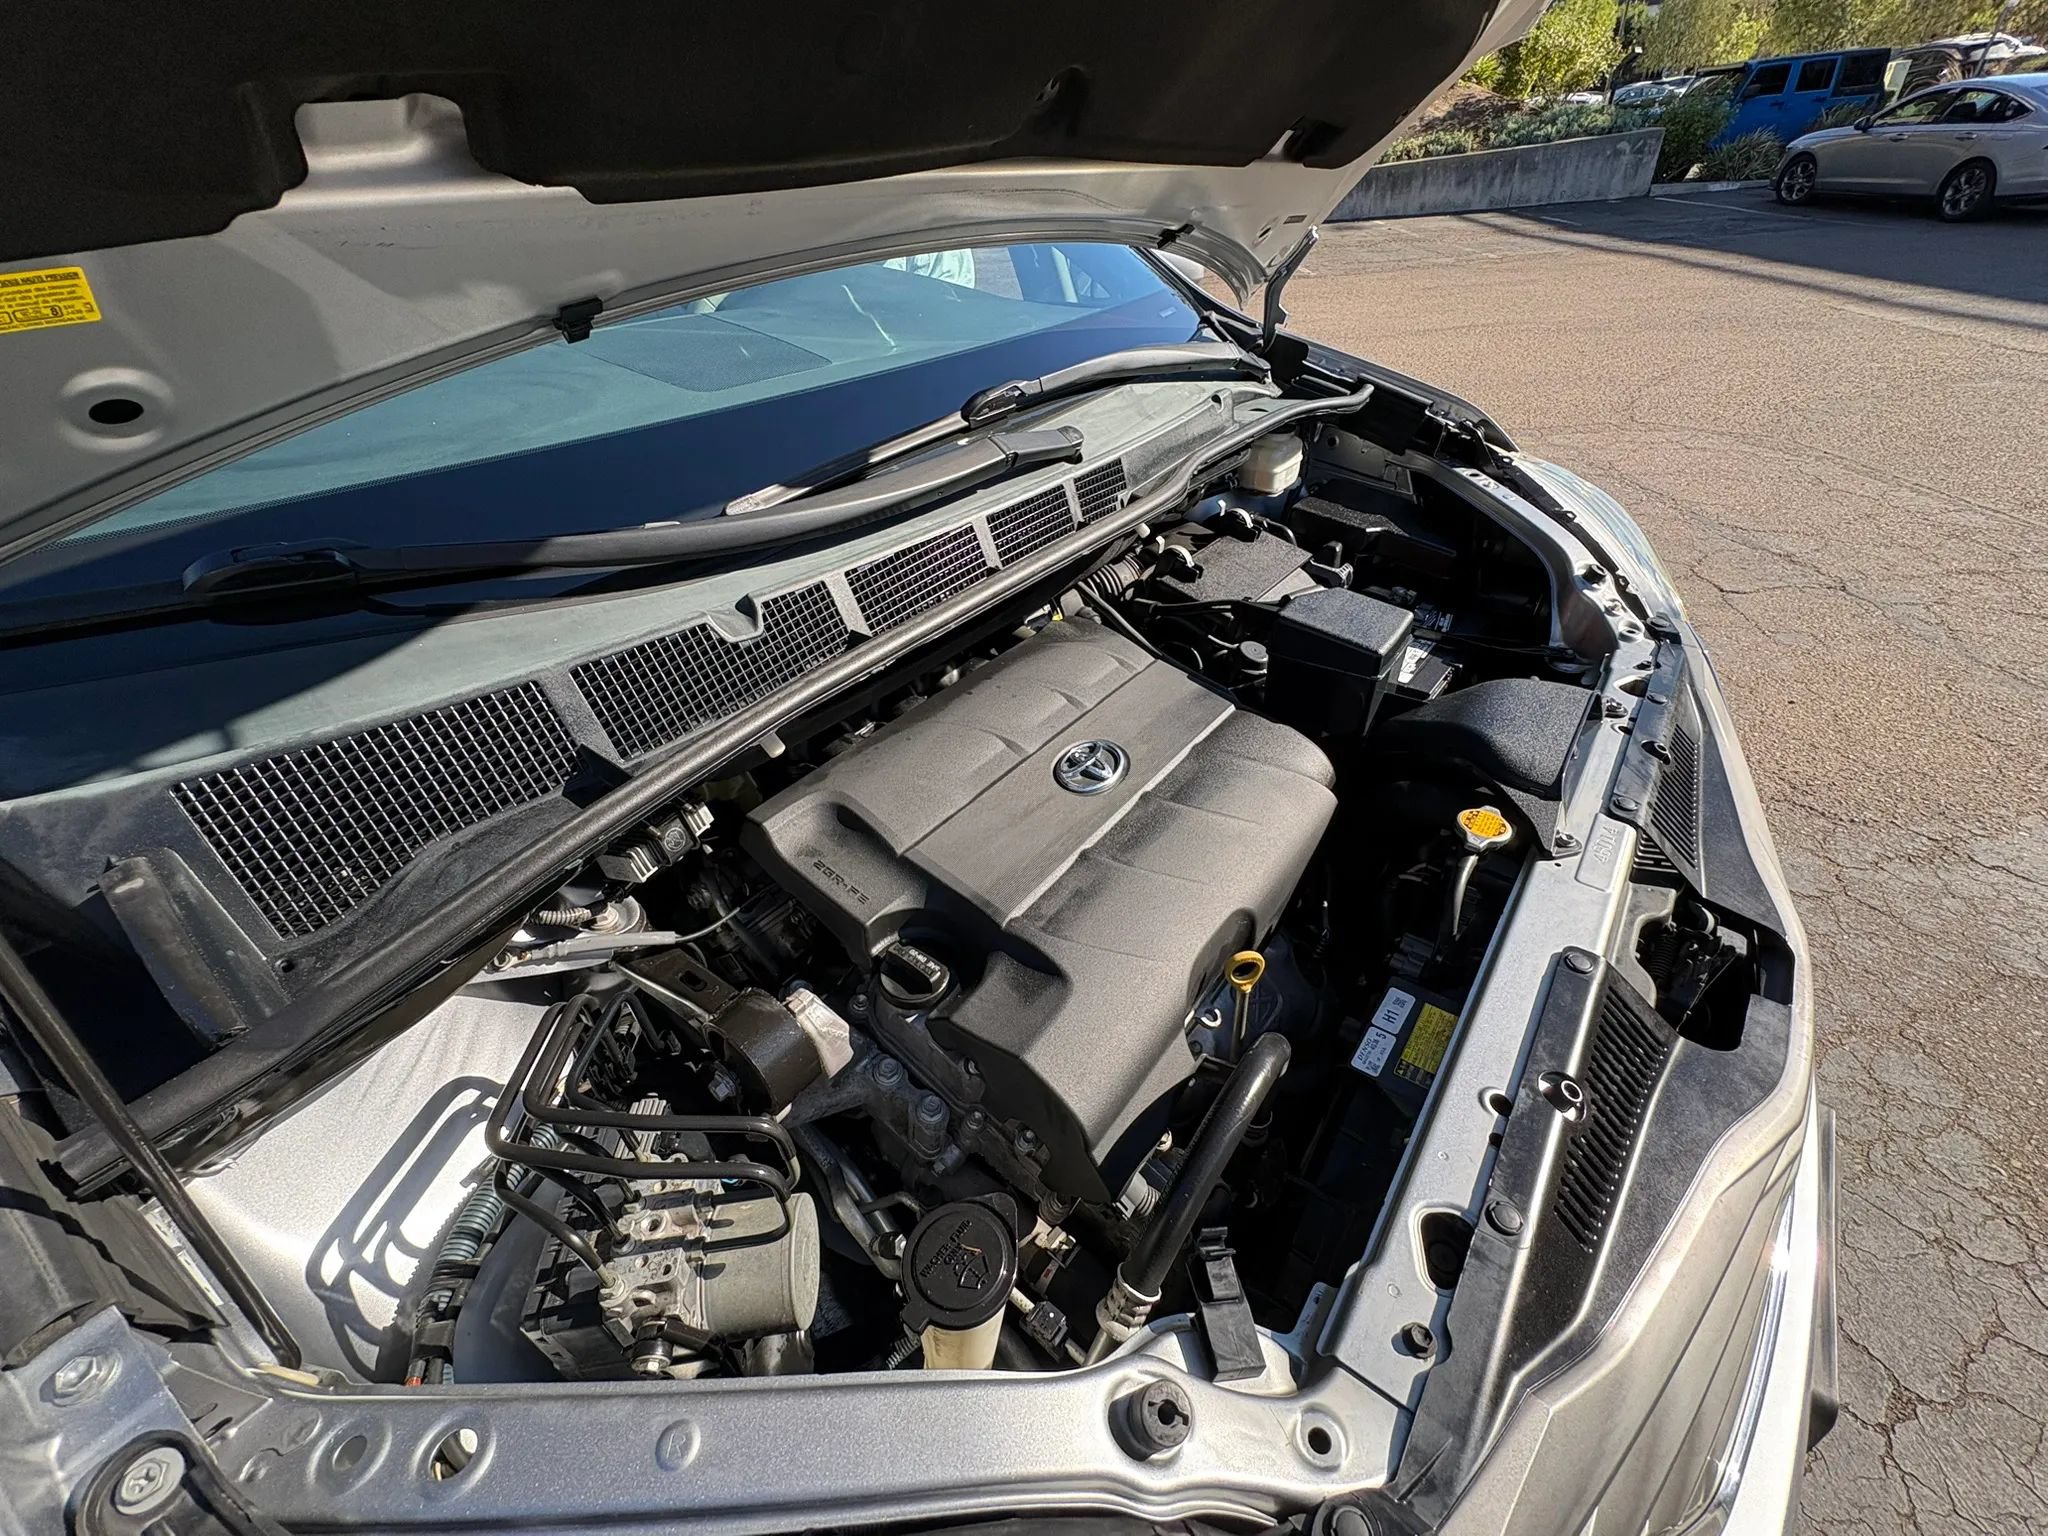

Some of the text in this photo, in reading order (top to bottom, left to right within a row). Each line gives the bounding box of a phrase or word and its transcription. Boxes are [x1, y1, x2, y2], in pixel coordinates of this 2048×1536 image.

[813, 859, 870, 905] 2GR-FE
[1382, 1009, 1399, 1024] H1
[1357, 1037, 1373, 1061] DENSO
